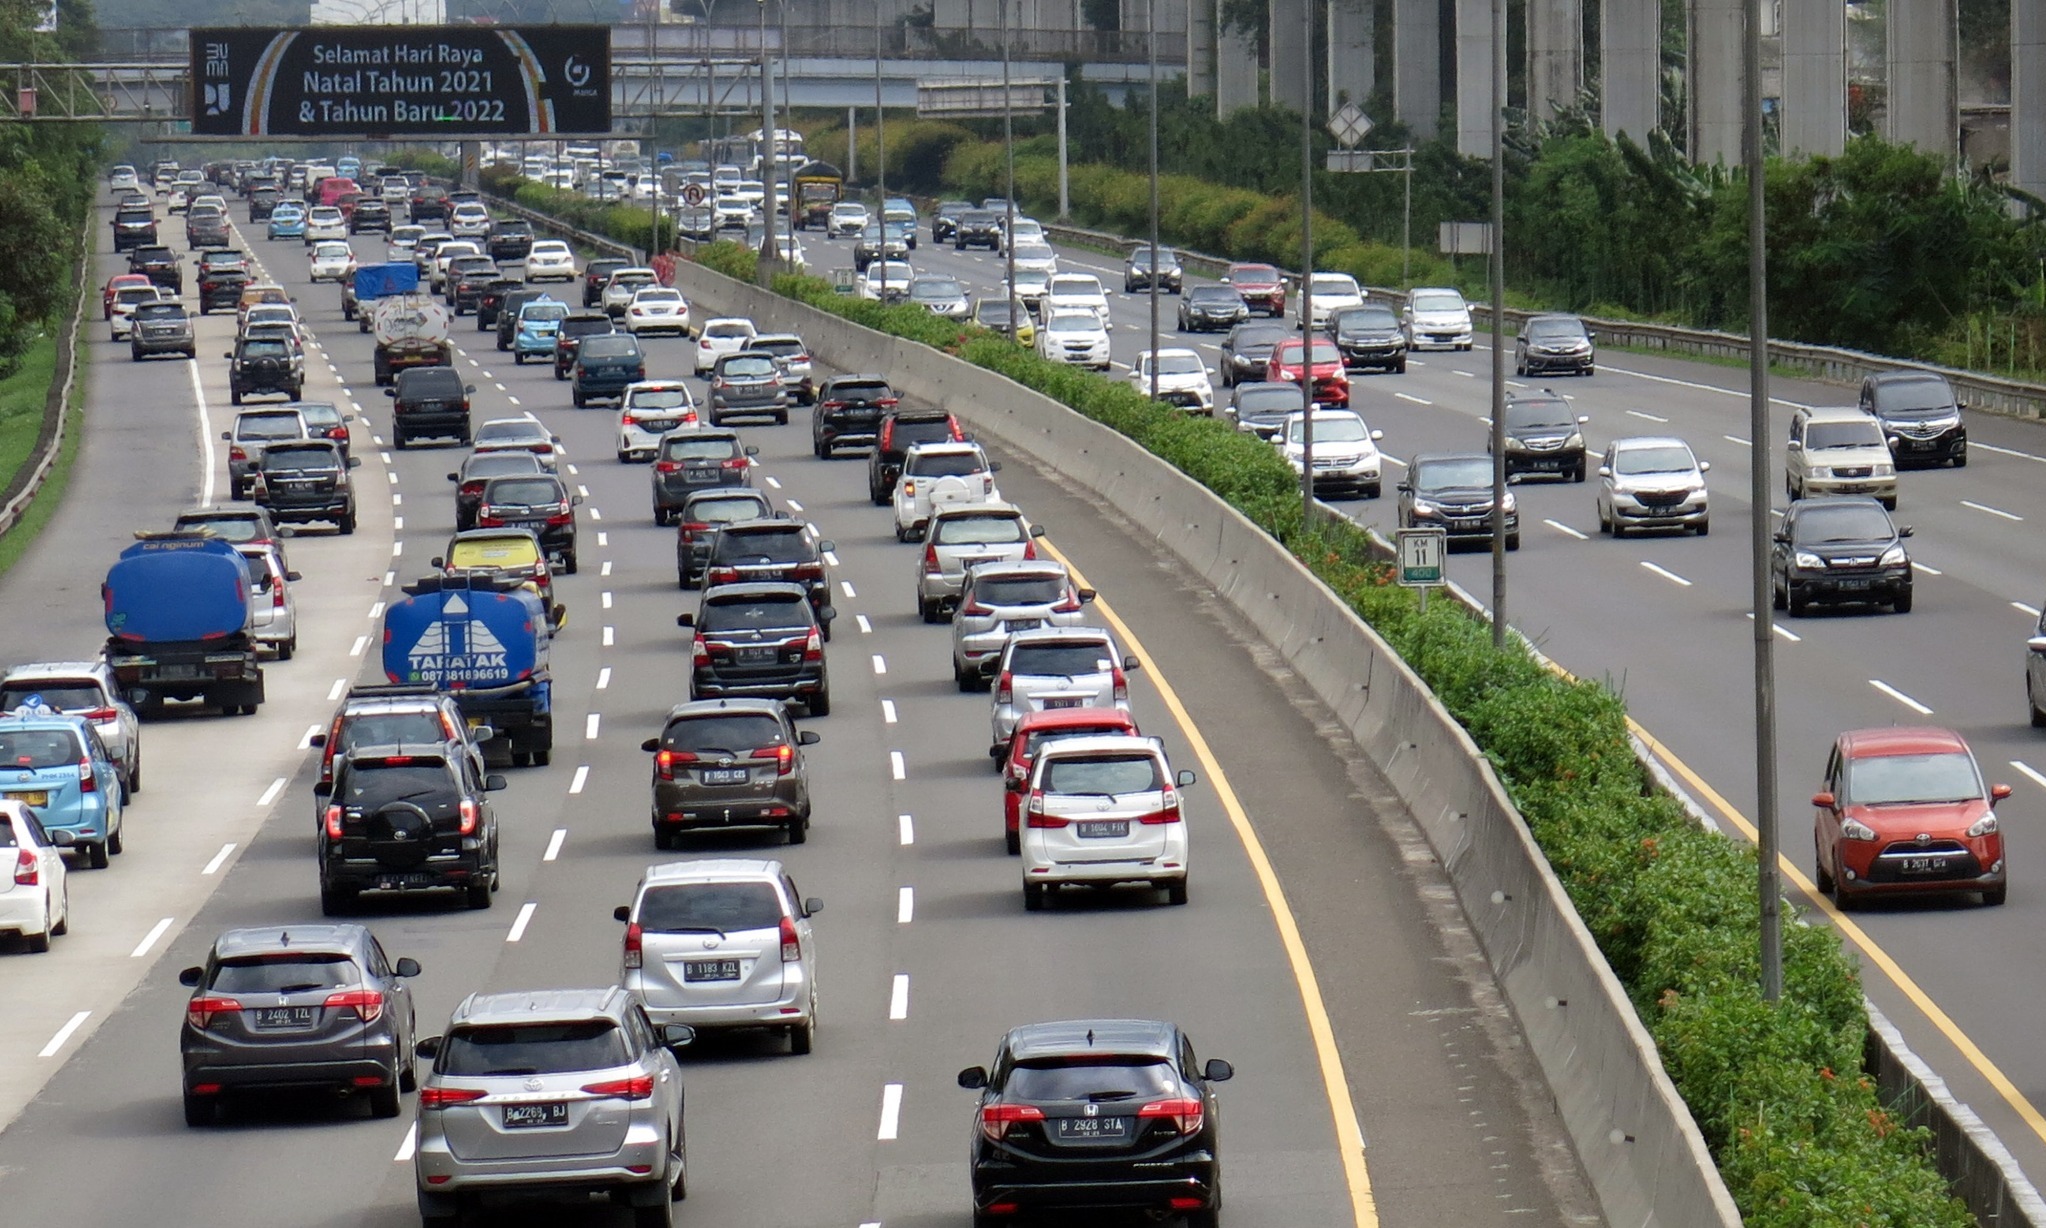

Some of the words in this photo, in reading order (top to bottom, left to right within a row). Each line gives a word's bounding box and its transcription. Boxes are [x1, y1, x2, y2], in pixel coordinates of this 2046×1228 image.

[313, 44, 389, 63] Selamat
[395, 44, 433, 63] Hari
[438, 44, 483, 68] Raya
[303, 70, 361, 93] Natal
[366, 70, 434, 93] Tahun
[440, 71, 492, 93] 2021
[300, 101, 315, 122] &
[320, 100, 387, 122] Tahun
[394, 100, 445, 122] Baru
[451, 100, 505, 122] 2022
[1413, 538, 1428, 548] KM
[1415, 549, 1427, 565] 11
[686, 964, 693, 974] B
[698, 962, 718, 973] 1183
[722, 961, 737, 972] KZL
[256, 1011, 262, 1020] B
[267, 1009, 289, 1020] 2402
[295, 1008, 311, 1019] TZL
[506, 1107, 513, 1119] B
[553, 1105, 566, 1117] BJ
[1061, 1120, 1068, 1131] B
[1073, 1118, 1098, 1131] 2928
[1104, 1117, 1123, 1130] STA
